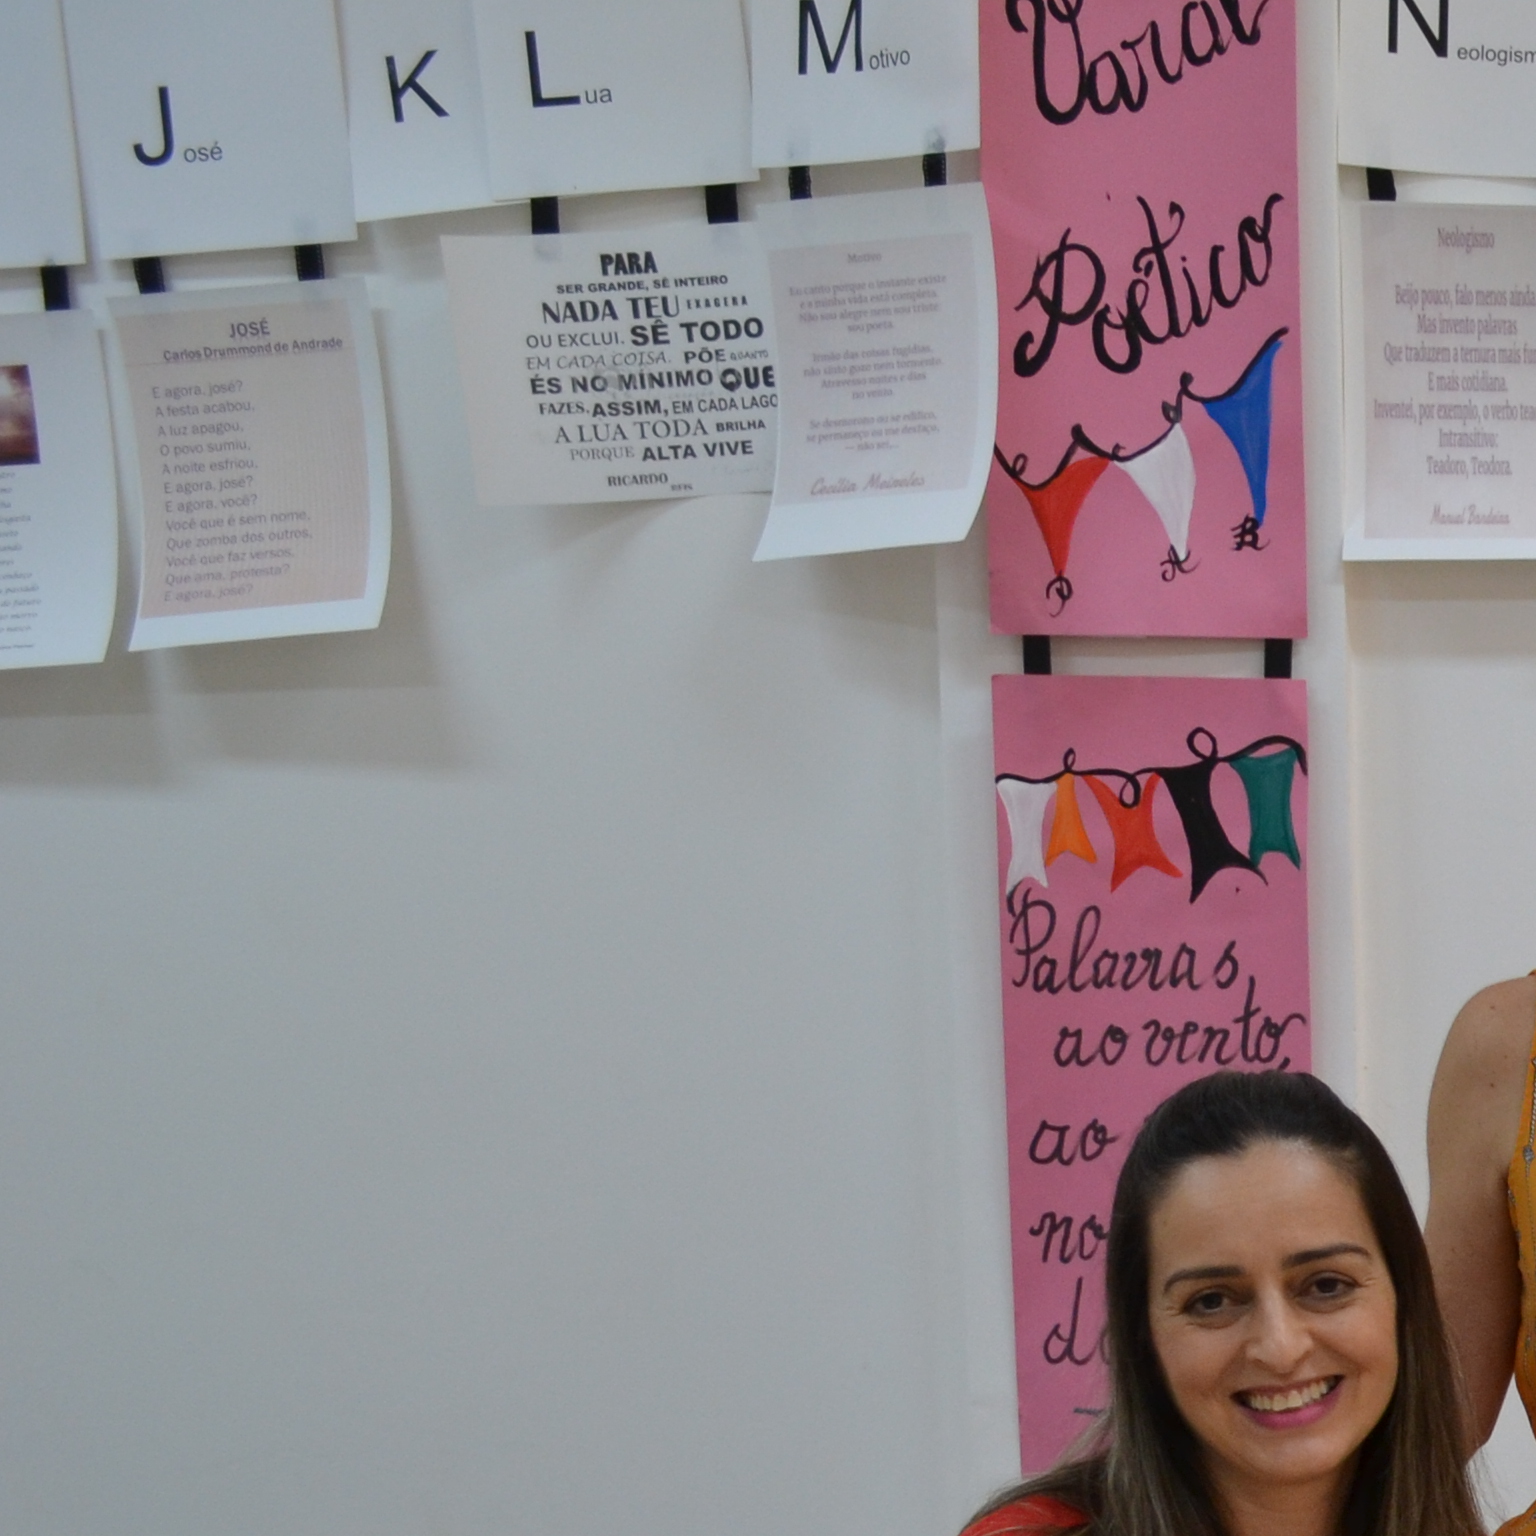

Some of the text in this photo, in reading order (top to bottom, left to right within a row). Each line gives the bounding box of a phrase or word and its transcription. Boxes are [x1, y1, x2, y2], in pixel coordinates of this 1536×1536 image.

[384, 49, 449, 123] K
[600, 251, 658, 276] PARA
[556, 275, 728, 294] SER GRANDE, SÊ INTEIRO
[542, 295, 748, 324] NADA TEU EXAGERA
[229, 317, 271, 338] JOSÉ
[526, 317, 764, 349] OU EXCLUI. SÊ TODO
[163, 336, 343, 362] Carlos Drummond de Andrade
[526, 356, 551, 371] EM
[557, 354, 606, 370] CADA
[683, 347, 726, 365] PÕE
[530, 365, 776, 395] ÉS NO MÍNIMO QUE
[539, 401, 590, 416] FAZES.
[591, 399, 669, 419] ASSIM,
[672, 400, 694, 414] EM
[698, 395, 739, 413] CADA
[554, 418, 767, 444] A LUA TODA BRILHA
[570, 440, 754, 462] PORQUE ALTA VIVE
[607, 472, 669, 487] RICARDO
[1054, 1020, 1129, 1068] ao
